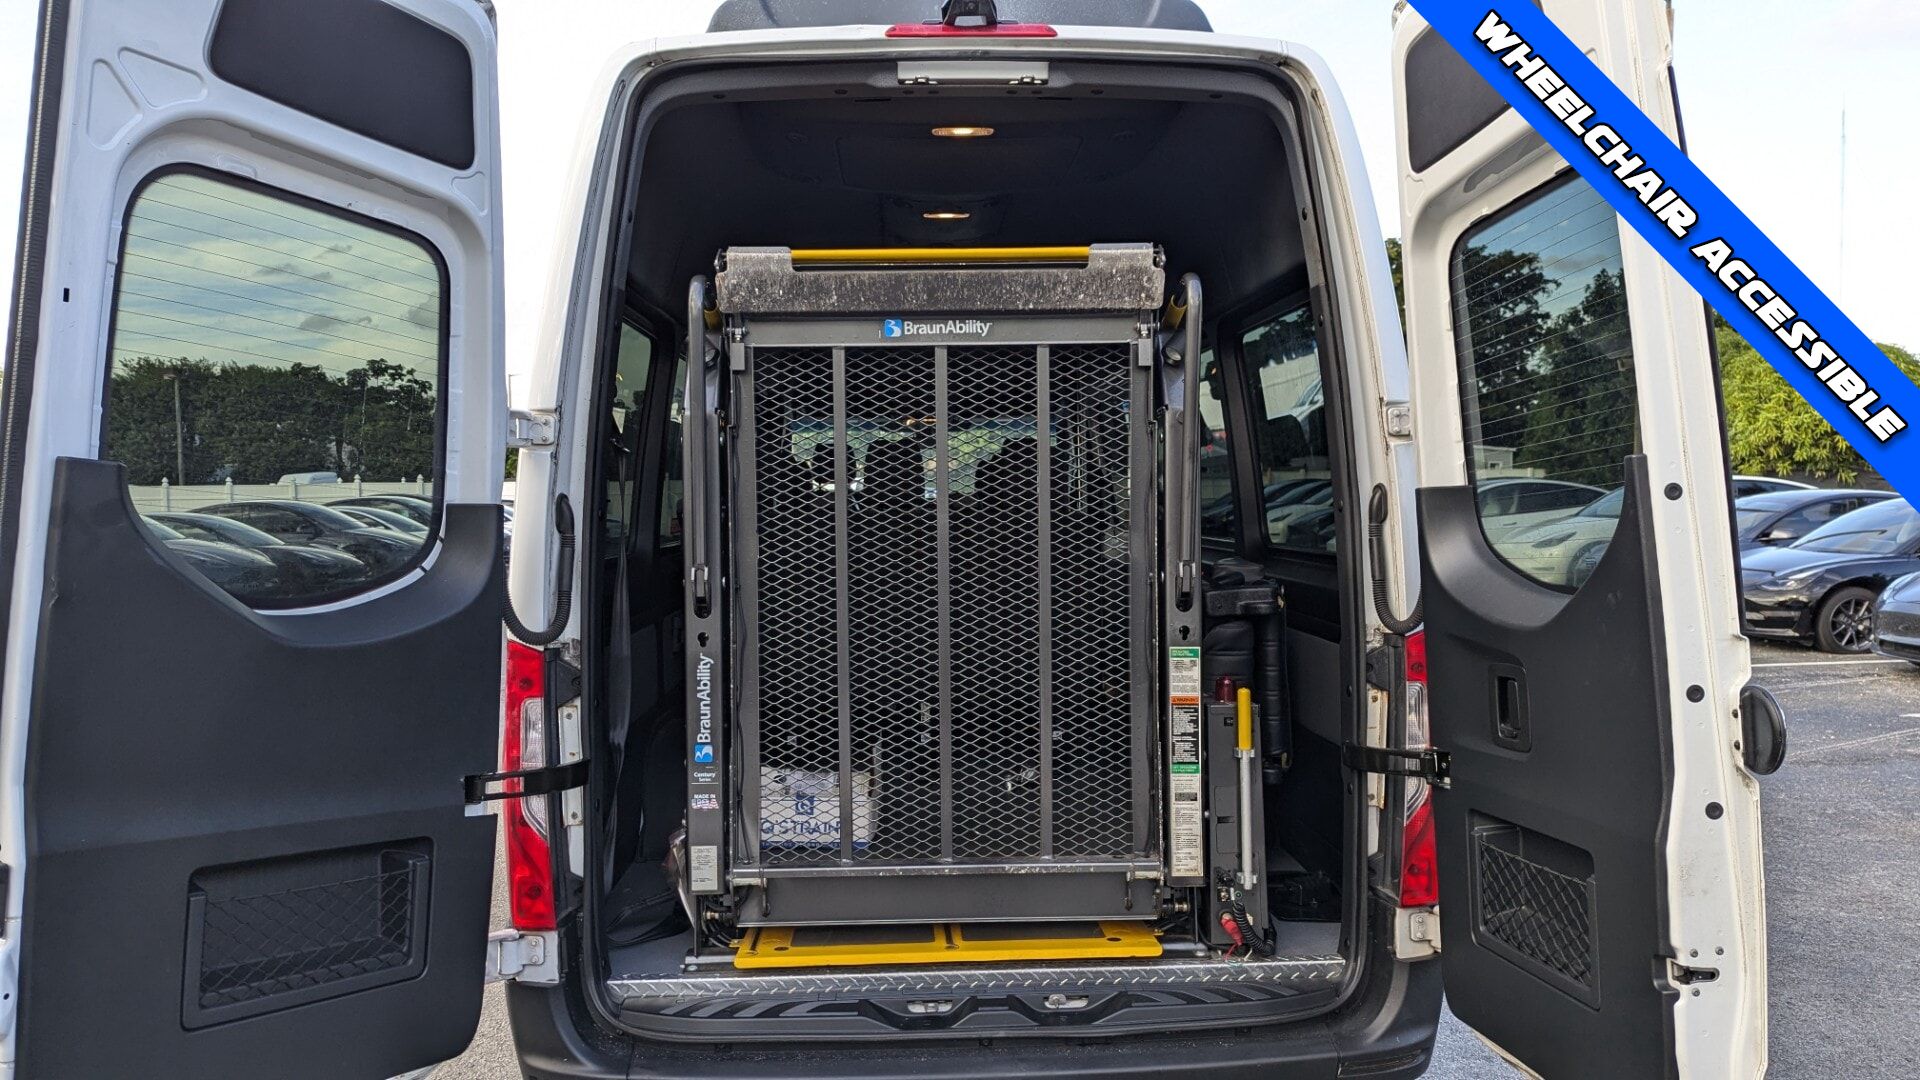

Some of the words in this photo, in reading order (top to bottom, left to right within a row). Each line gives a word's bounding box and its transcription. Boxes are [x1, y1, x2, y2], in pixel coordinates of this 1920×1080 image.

[903, 319, 992, 337] BraunAbility
[696, 653, 714, 743] BraunAbility
[691, 798, 720, 809] USA
